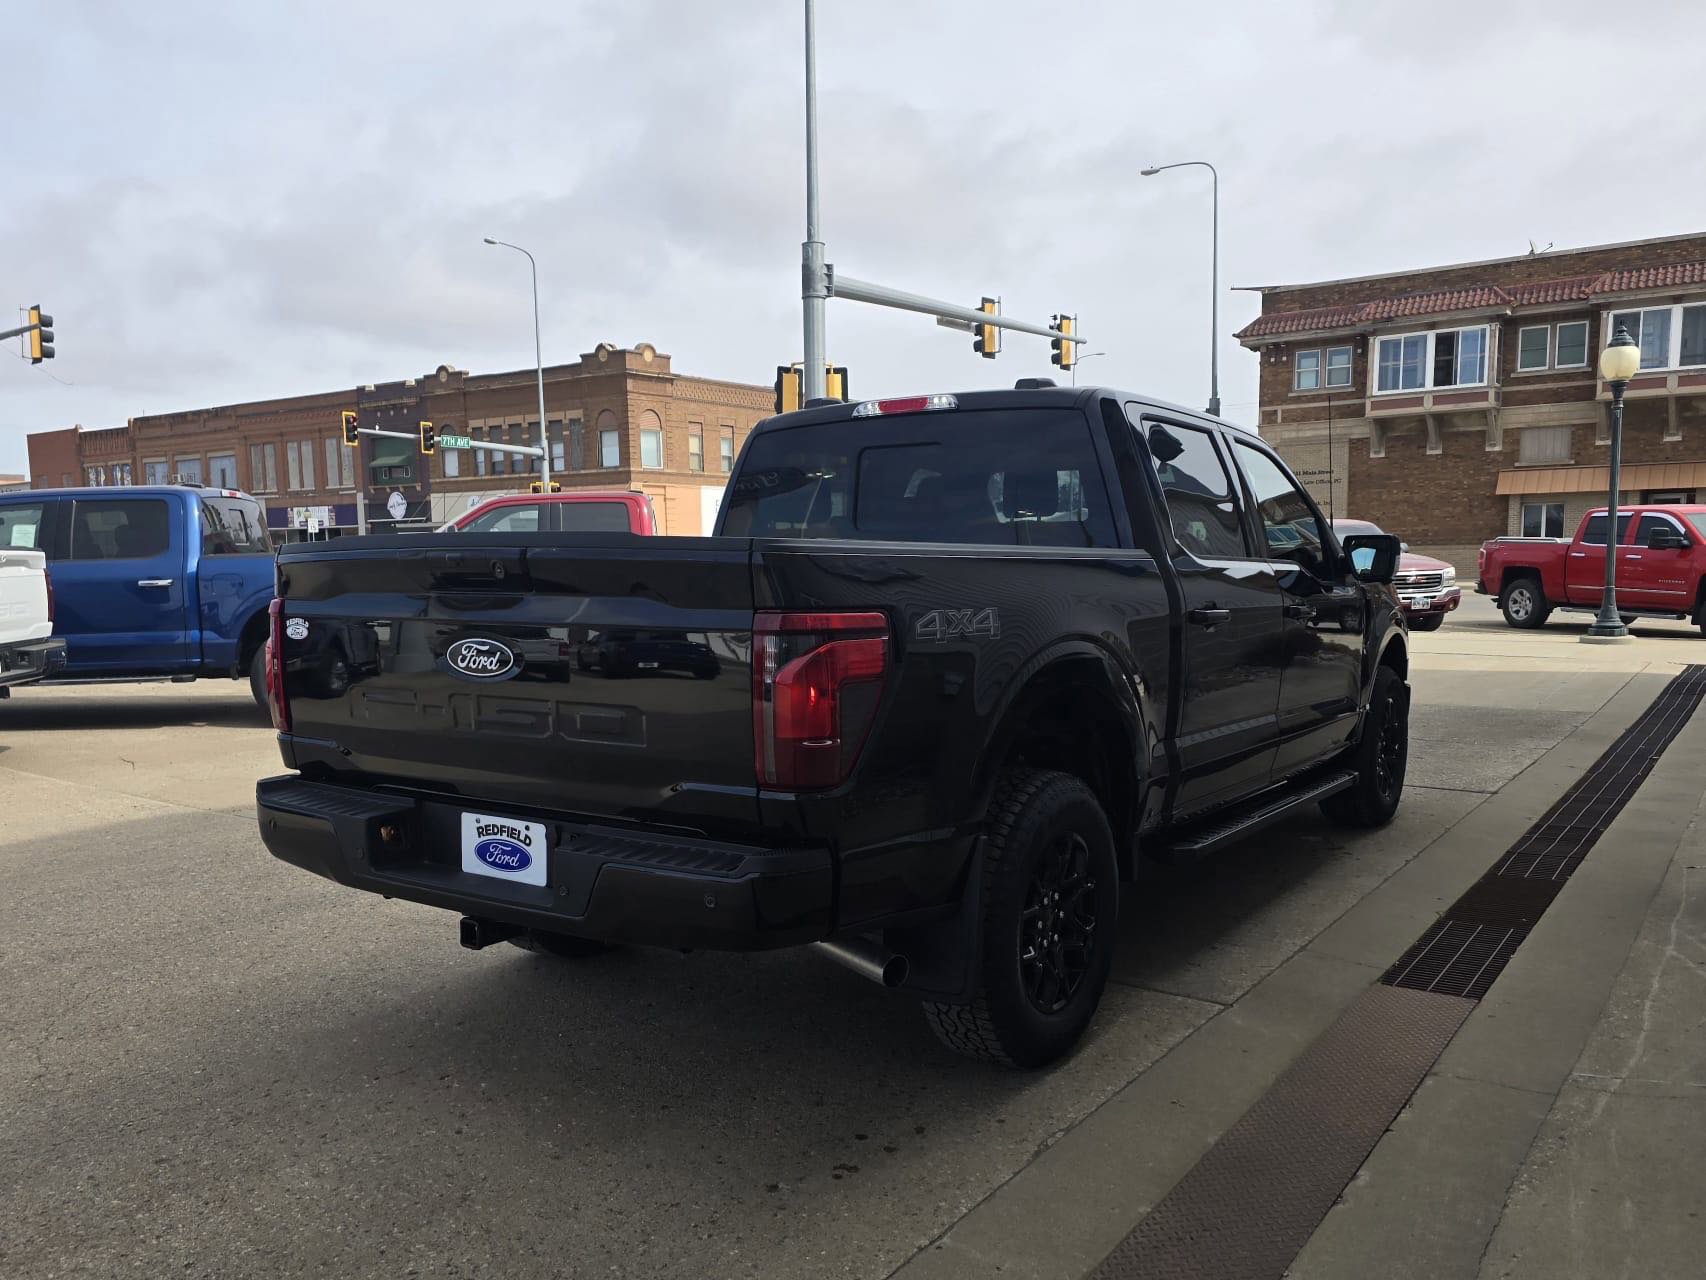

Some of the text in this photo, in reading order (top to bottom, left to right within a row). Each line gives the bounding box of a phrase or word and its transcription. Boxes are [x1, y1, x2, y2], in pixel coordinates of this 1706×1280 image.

[443, 436, 469, 447] 7TH AVE
[286, 617, 309, 628] REDFIELD
[457, 642, 501, 670] Ford
[476, 823, 532, 847] REDFIELD
[486, 843, 520, 867] Ford
